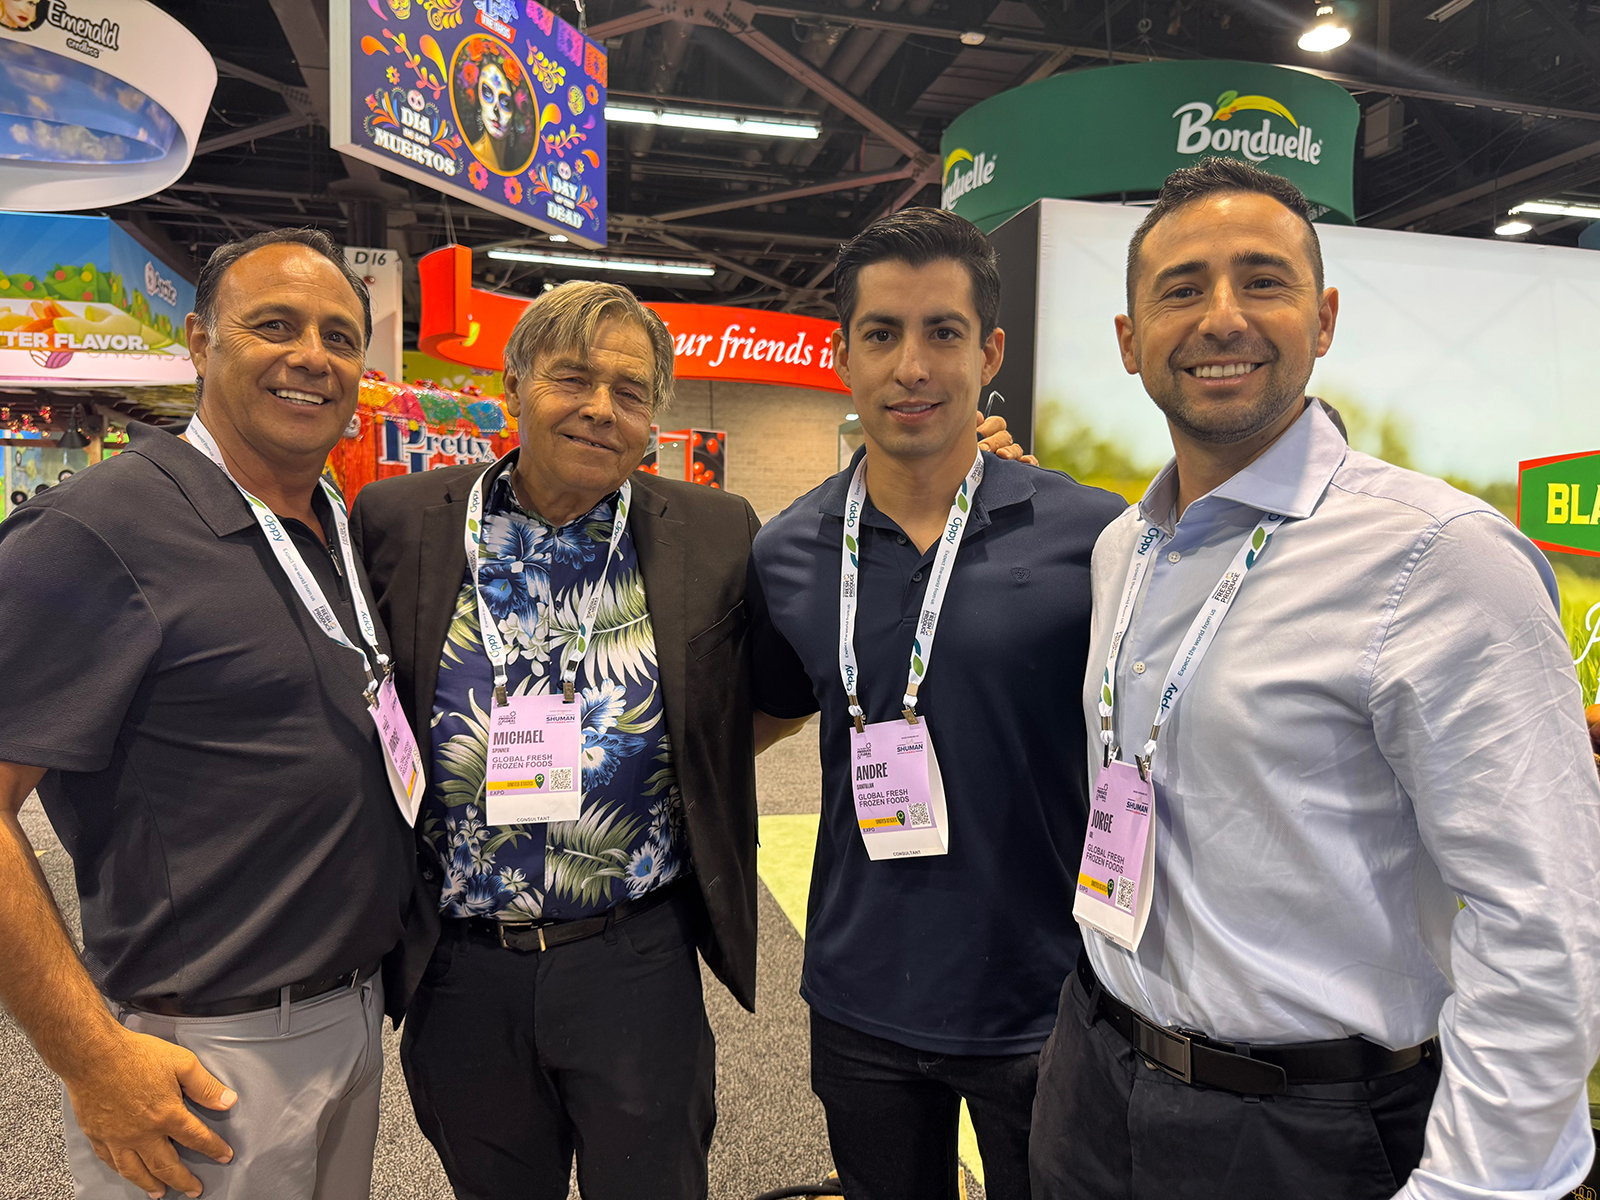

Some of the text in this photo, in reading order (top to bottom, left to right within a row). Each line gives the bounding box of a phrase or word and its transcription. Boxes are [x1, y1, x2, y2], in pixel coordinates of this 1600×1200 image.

[47, 0, 119, 51] Emerald
[401, 106, 432, 136] DIA
[1172, 102, 1322, 165] Bonduelle
[374, 126, 456, 176] MUERTOS
[551, 175, 578, 200] DAY
[547, 200, 585, 229] DEAD
[53, 333, 149, 350] FLAVOR.
[674, 333, 713, 357] ur
[709, 323, 813, 367] friends
[378, 419, 492, 465] Pretty
[847, 500, 860, 528] Oppy
[264, 514, 285, 542] Oppy
[946, 517, 963, 545] Oppy
[1137, 527, 1160, 556] Oppy
[941, 550, 949, 566] Expect
[1214, 579, 1230, 601] FRESH
[1220, 572, 1241, 604] PRODUCE
[319, 604, 332, 625] FRESH
[361, 610, 374, 637] Oppy
[920, 610, 929, 635] PRODUCE
[928, 611, 936, 631] FRESH
[486, 633, 502, 658] Oppy
[1178, 608, 1216, 676] Expect the world from us
[846, 664, 854, 691] Oppy
[1161, 682, 1179, 714] ppy
[493, 730, 544, 745] MICHAEL
[897, 744, 923, 752] SHUMAN
[492, 755, 525, 763] GLOBAL
[492, 760, 553, 770] FROZEN FOODS
[856, 762, 888, 781] ANDRE
[858, 788, 908, 801] GLOBAL FRESH
[859, 796, 910, 808] FROZEN FOODS
[1126, 801, 1148, 813] SHUMAN
[1091, 809, 1114, 833] JORGE
[1085, 852, 1124, 874] FROZEN FOODS
[1087, 843, 1125, 865] GLOBAL FRESH
